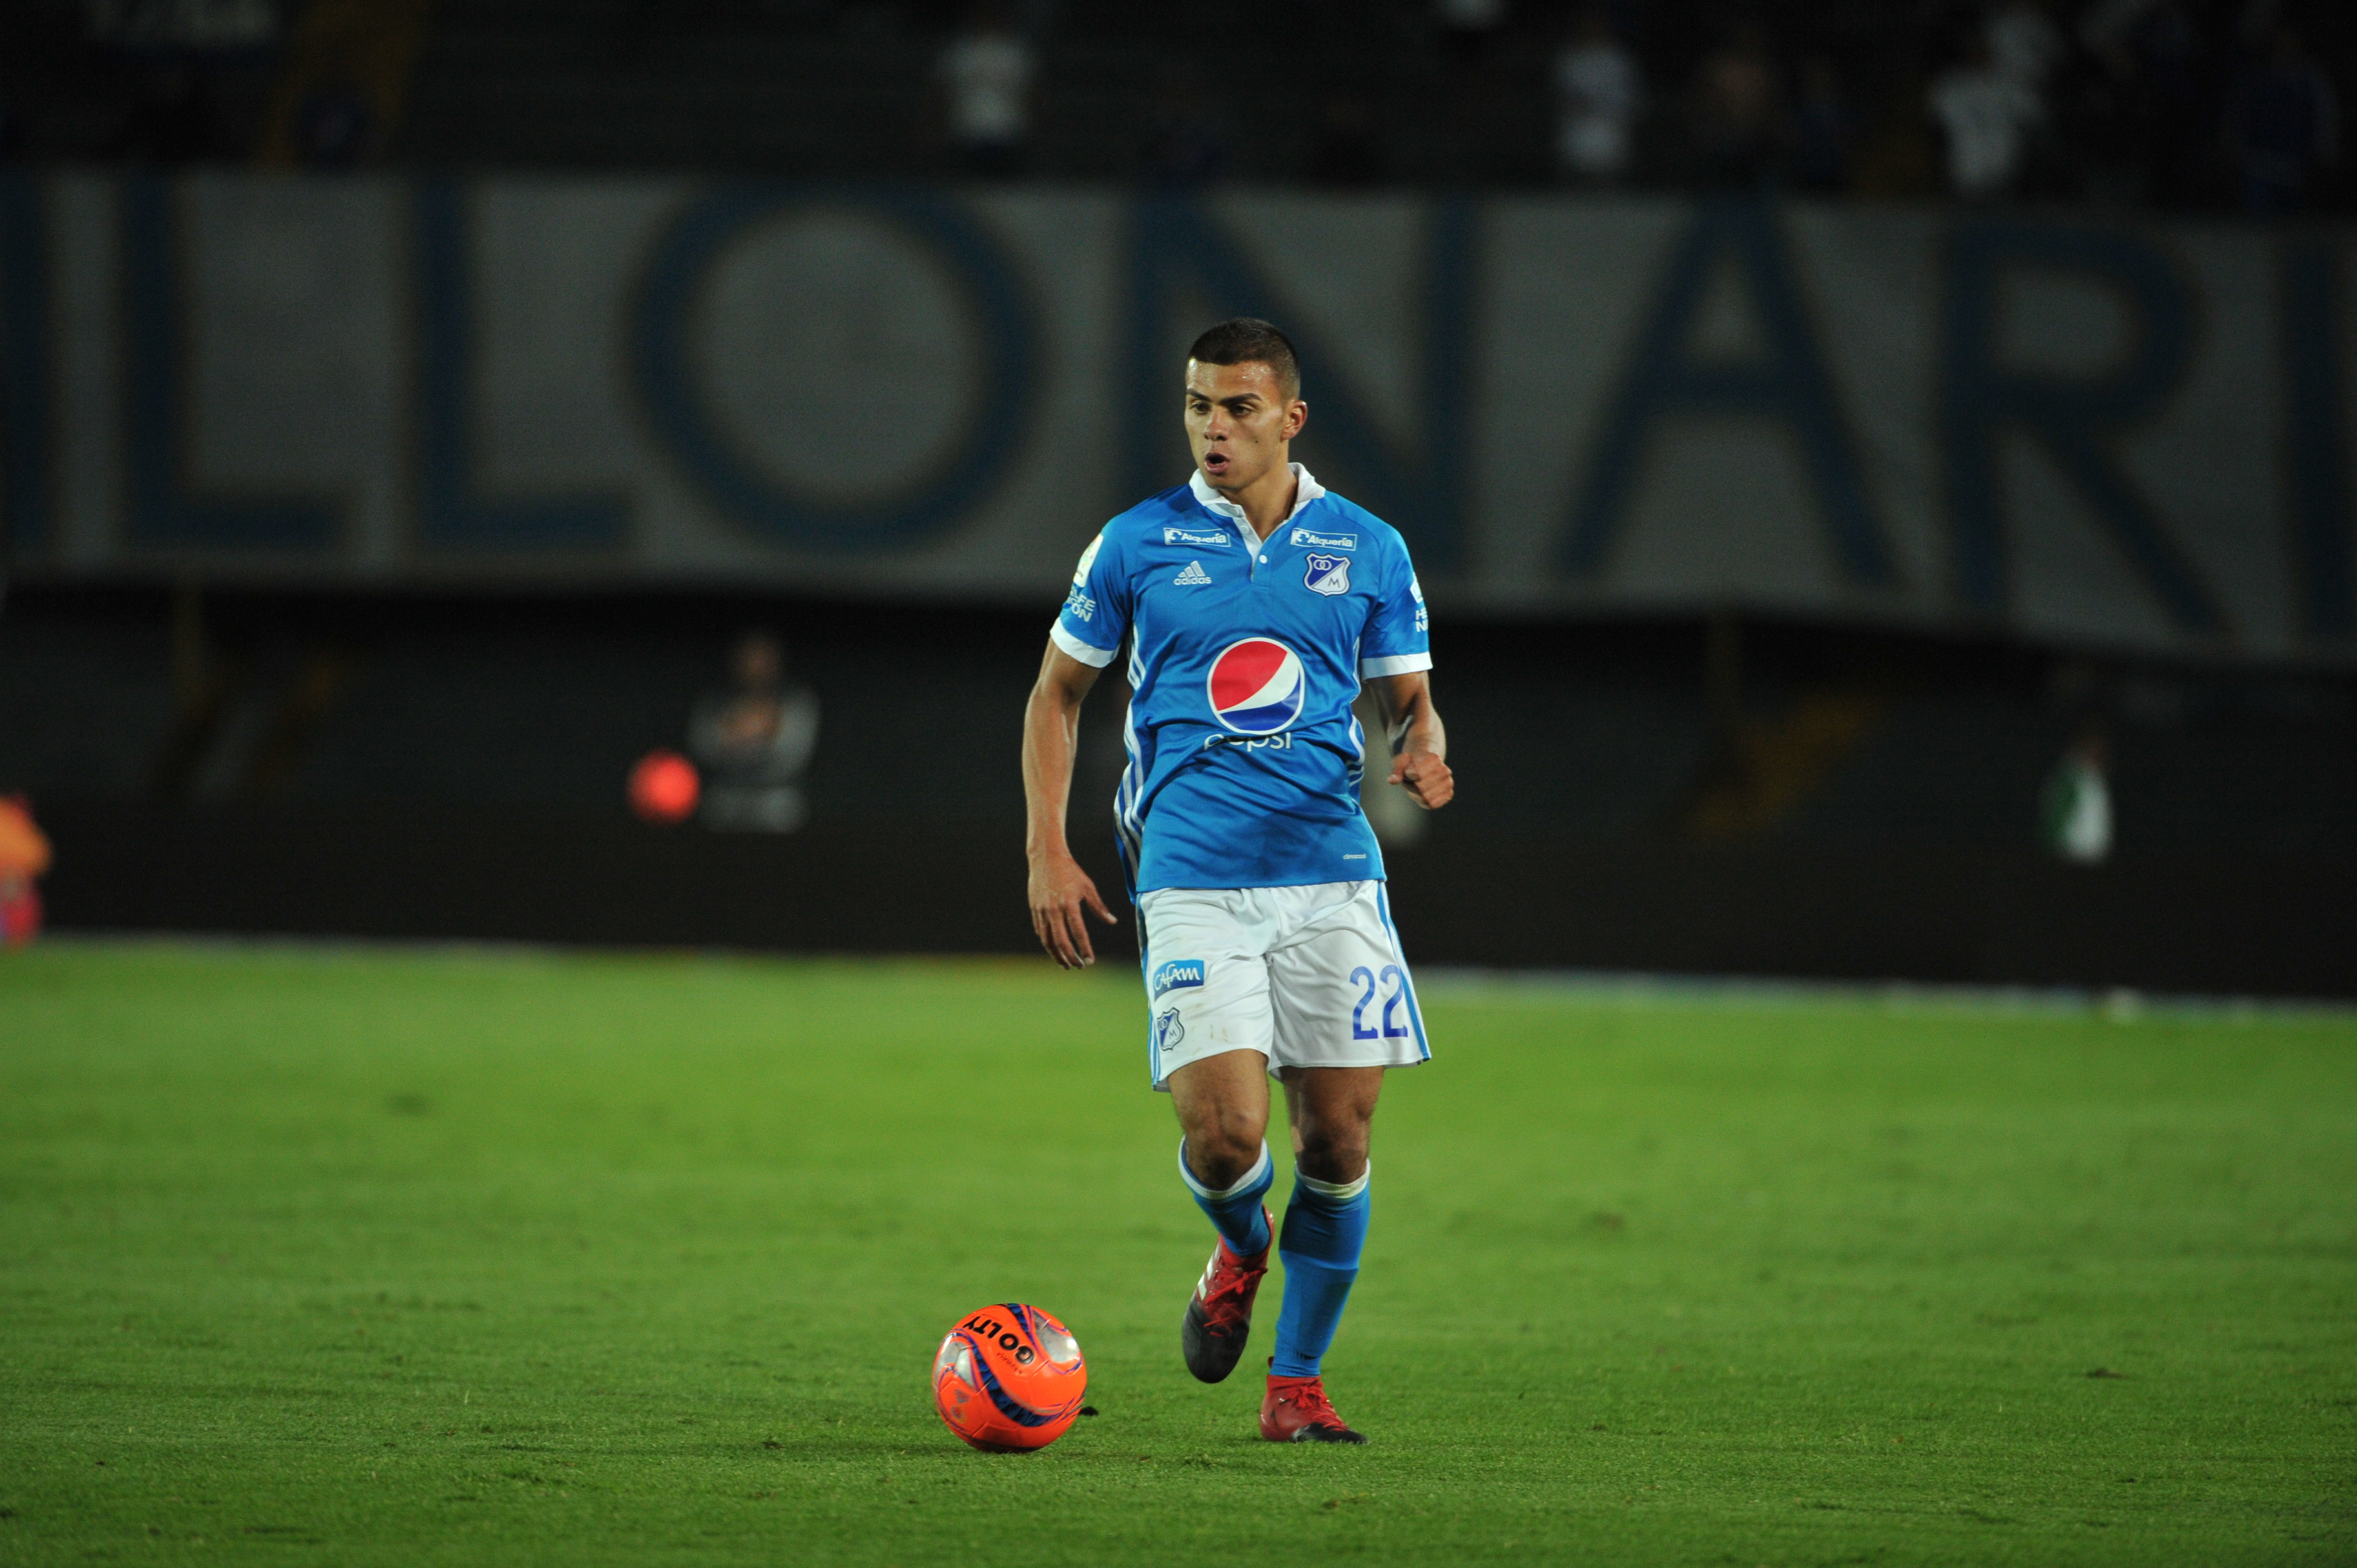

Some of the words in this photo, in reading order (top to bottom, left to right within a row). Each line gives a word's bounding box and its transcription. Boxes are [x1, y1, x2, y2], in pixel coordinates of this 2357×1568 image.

[1173, 576, 1212, 586] adidas
[1349, 964, 1408, 1040] 22
[963, 1316, 1035, 1365] GOLTY
